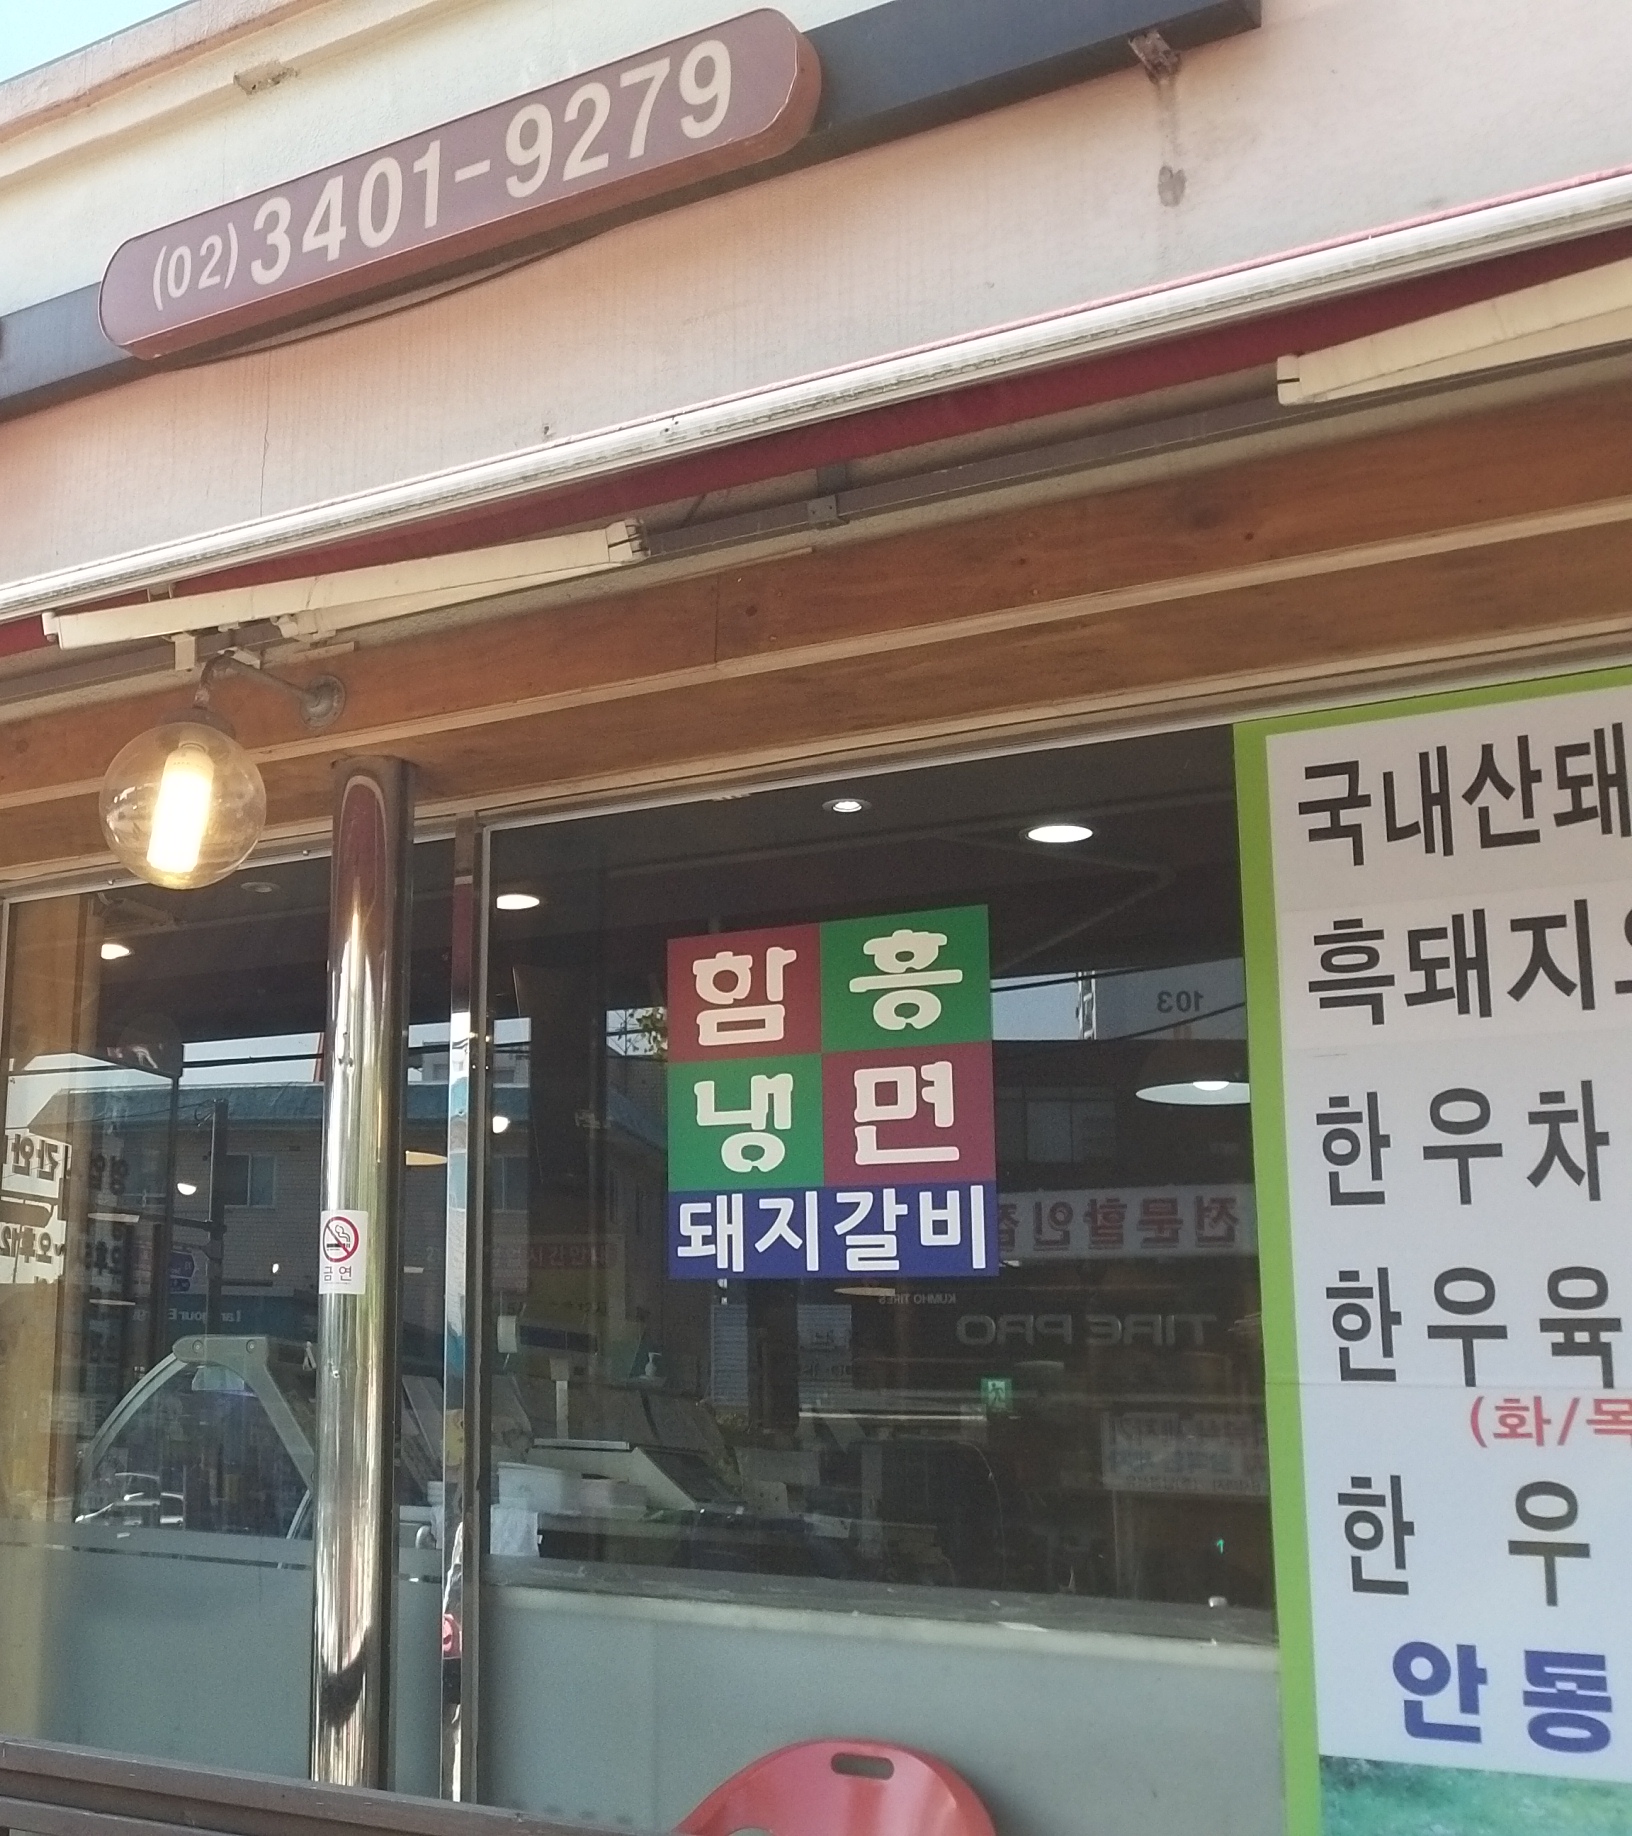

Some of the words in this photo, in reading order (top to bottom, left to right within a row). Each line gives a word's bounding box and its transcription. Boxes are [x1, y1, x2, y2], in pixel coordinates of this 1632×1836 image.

[1297, 721, 1632, 867] 국내산돼
[692, 929, 963, 1046] 함흥
[693, 1060, 960, 1173] 냉면
[323, 1265, 352, 1281] 금연
[676, 1184, 987, 1273] 돼지갈비
